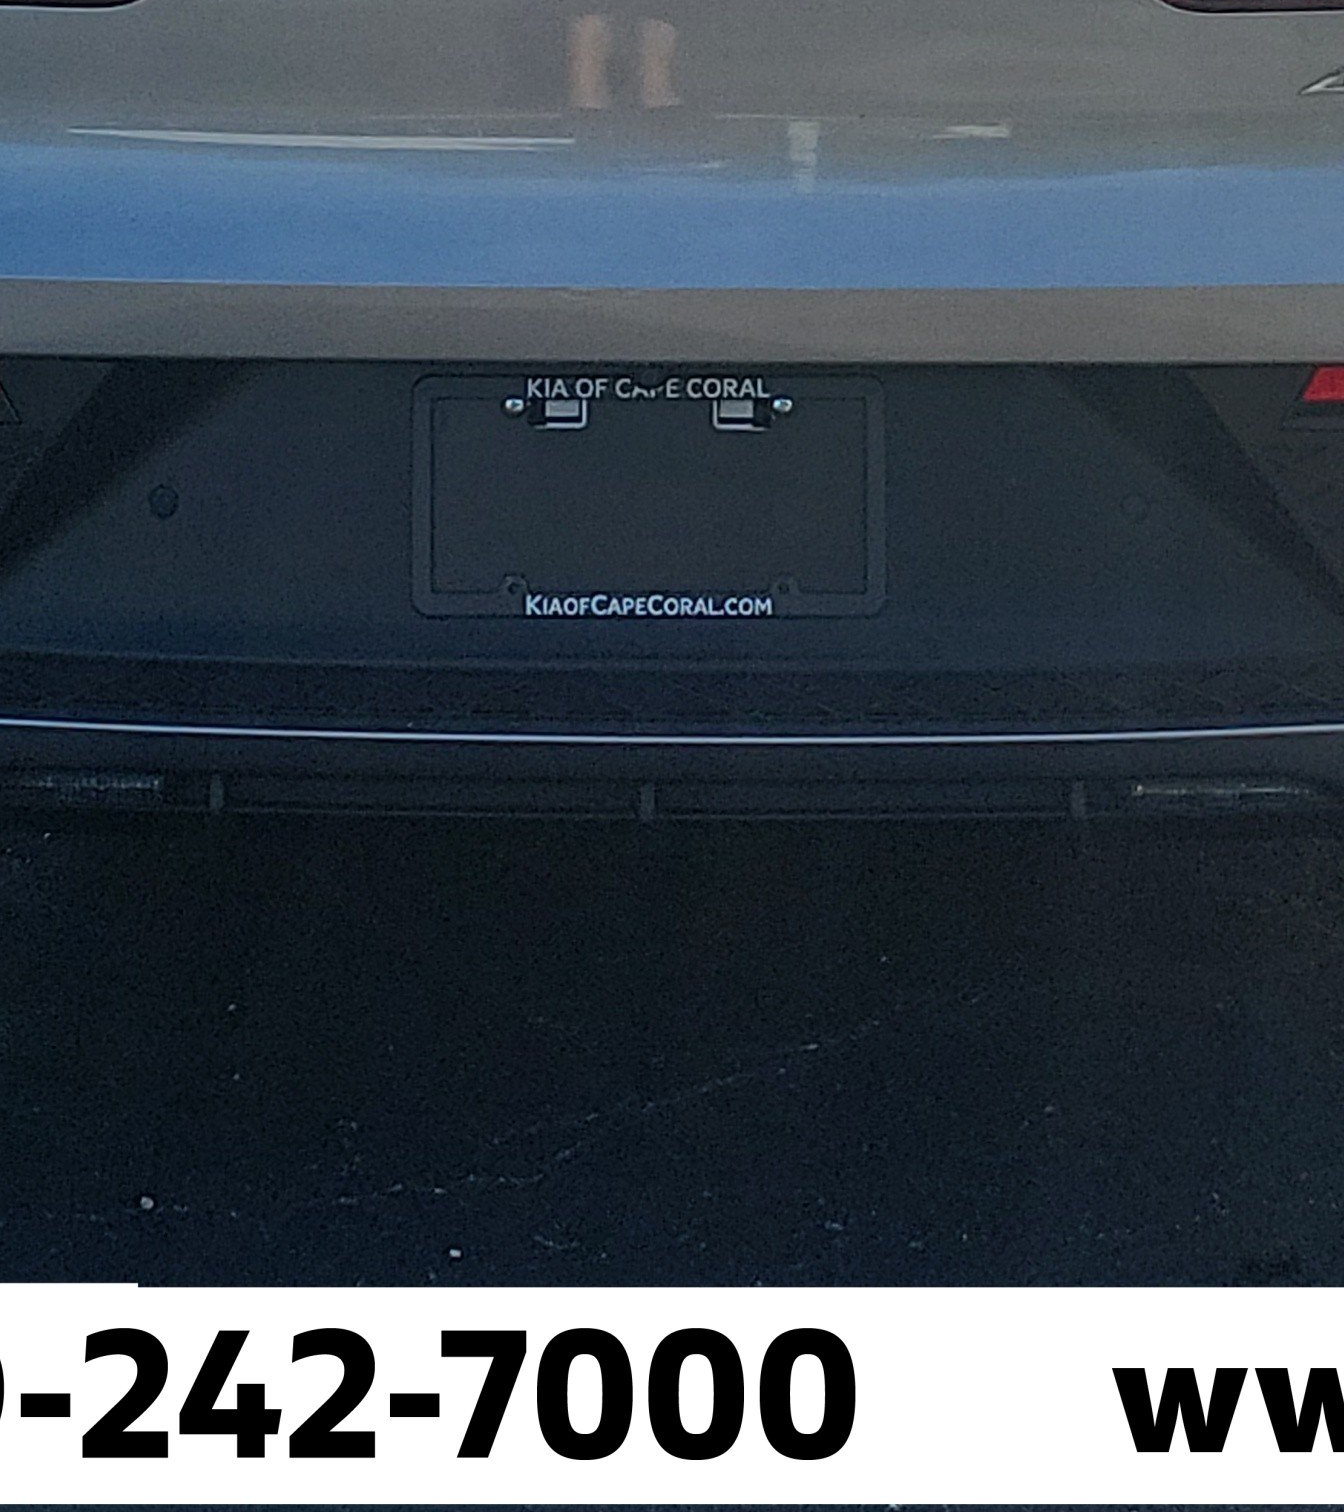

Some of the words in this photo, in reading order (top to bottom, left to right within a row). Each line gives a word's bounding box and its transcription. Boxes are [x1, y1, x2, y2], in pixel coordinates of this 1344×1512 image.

[526, 377, 570, 399] KIA
[575, 377, 608, 399] OF
[686, 377, 771, 399] CORAL
